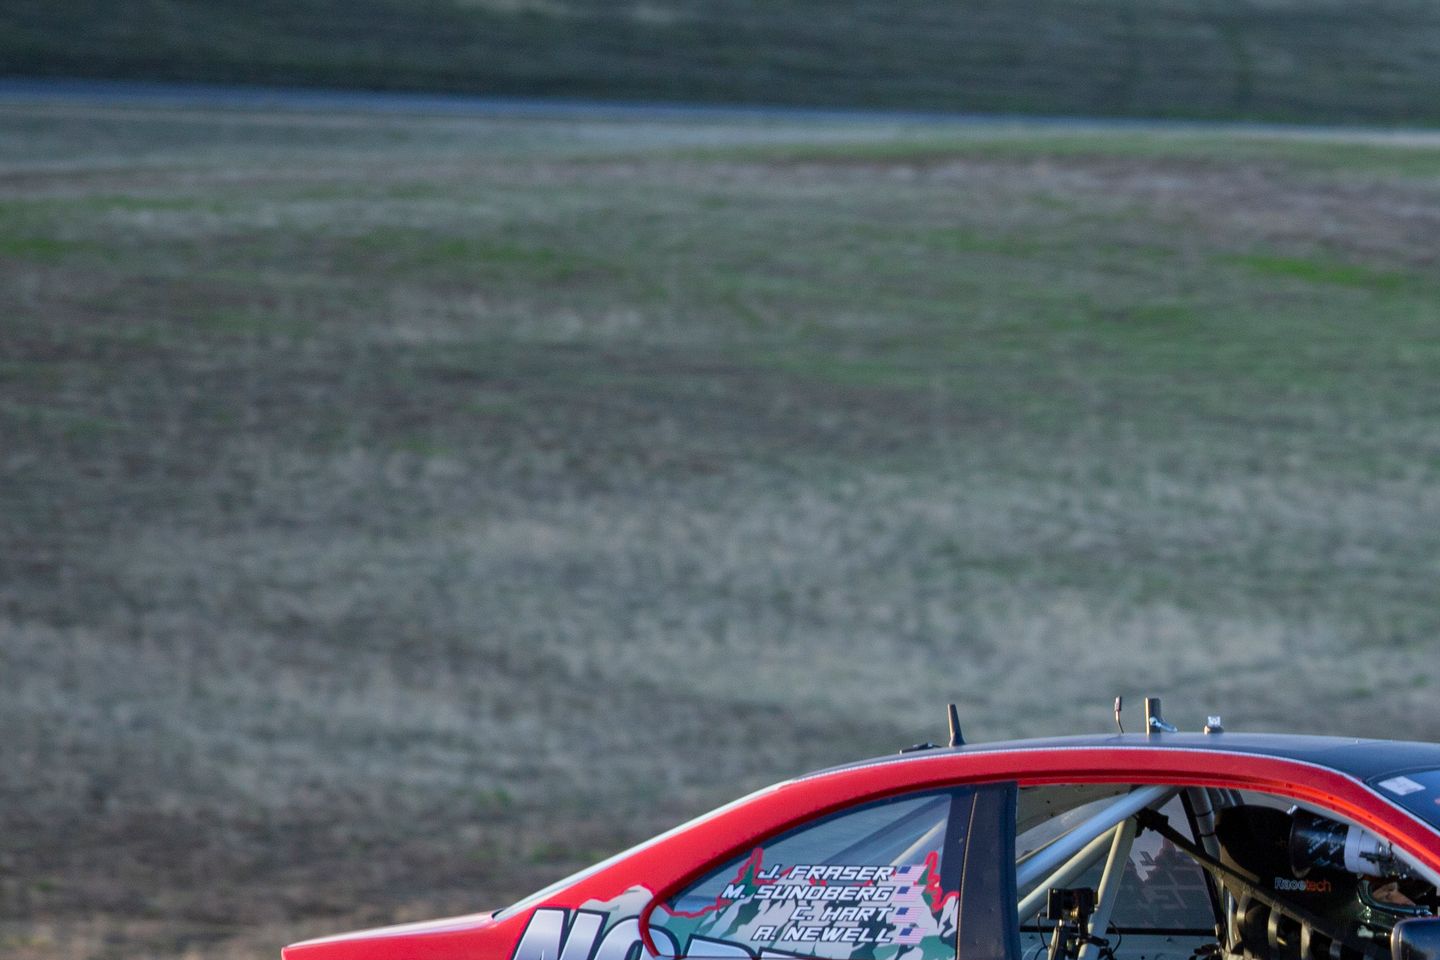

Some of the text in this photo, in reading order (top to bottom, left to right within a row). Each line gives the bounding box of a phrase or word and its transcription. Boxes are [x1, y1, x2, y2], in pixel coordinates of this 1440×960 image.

[757, 865, 897, 882] J. FRASER
[721, 884, 897, 902] M. SUNDBERG
[791, 906, 896, 923] C. HART
[752, 926, 896, 944] A. NEWELL
